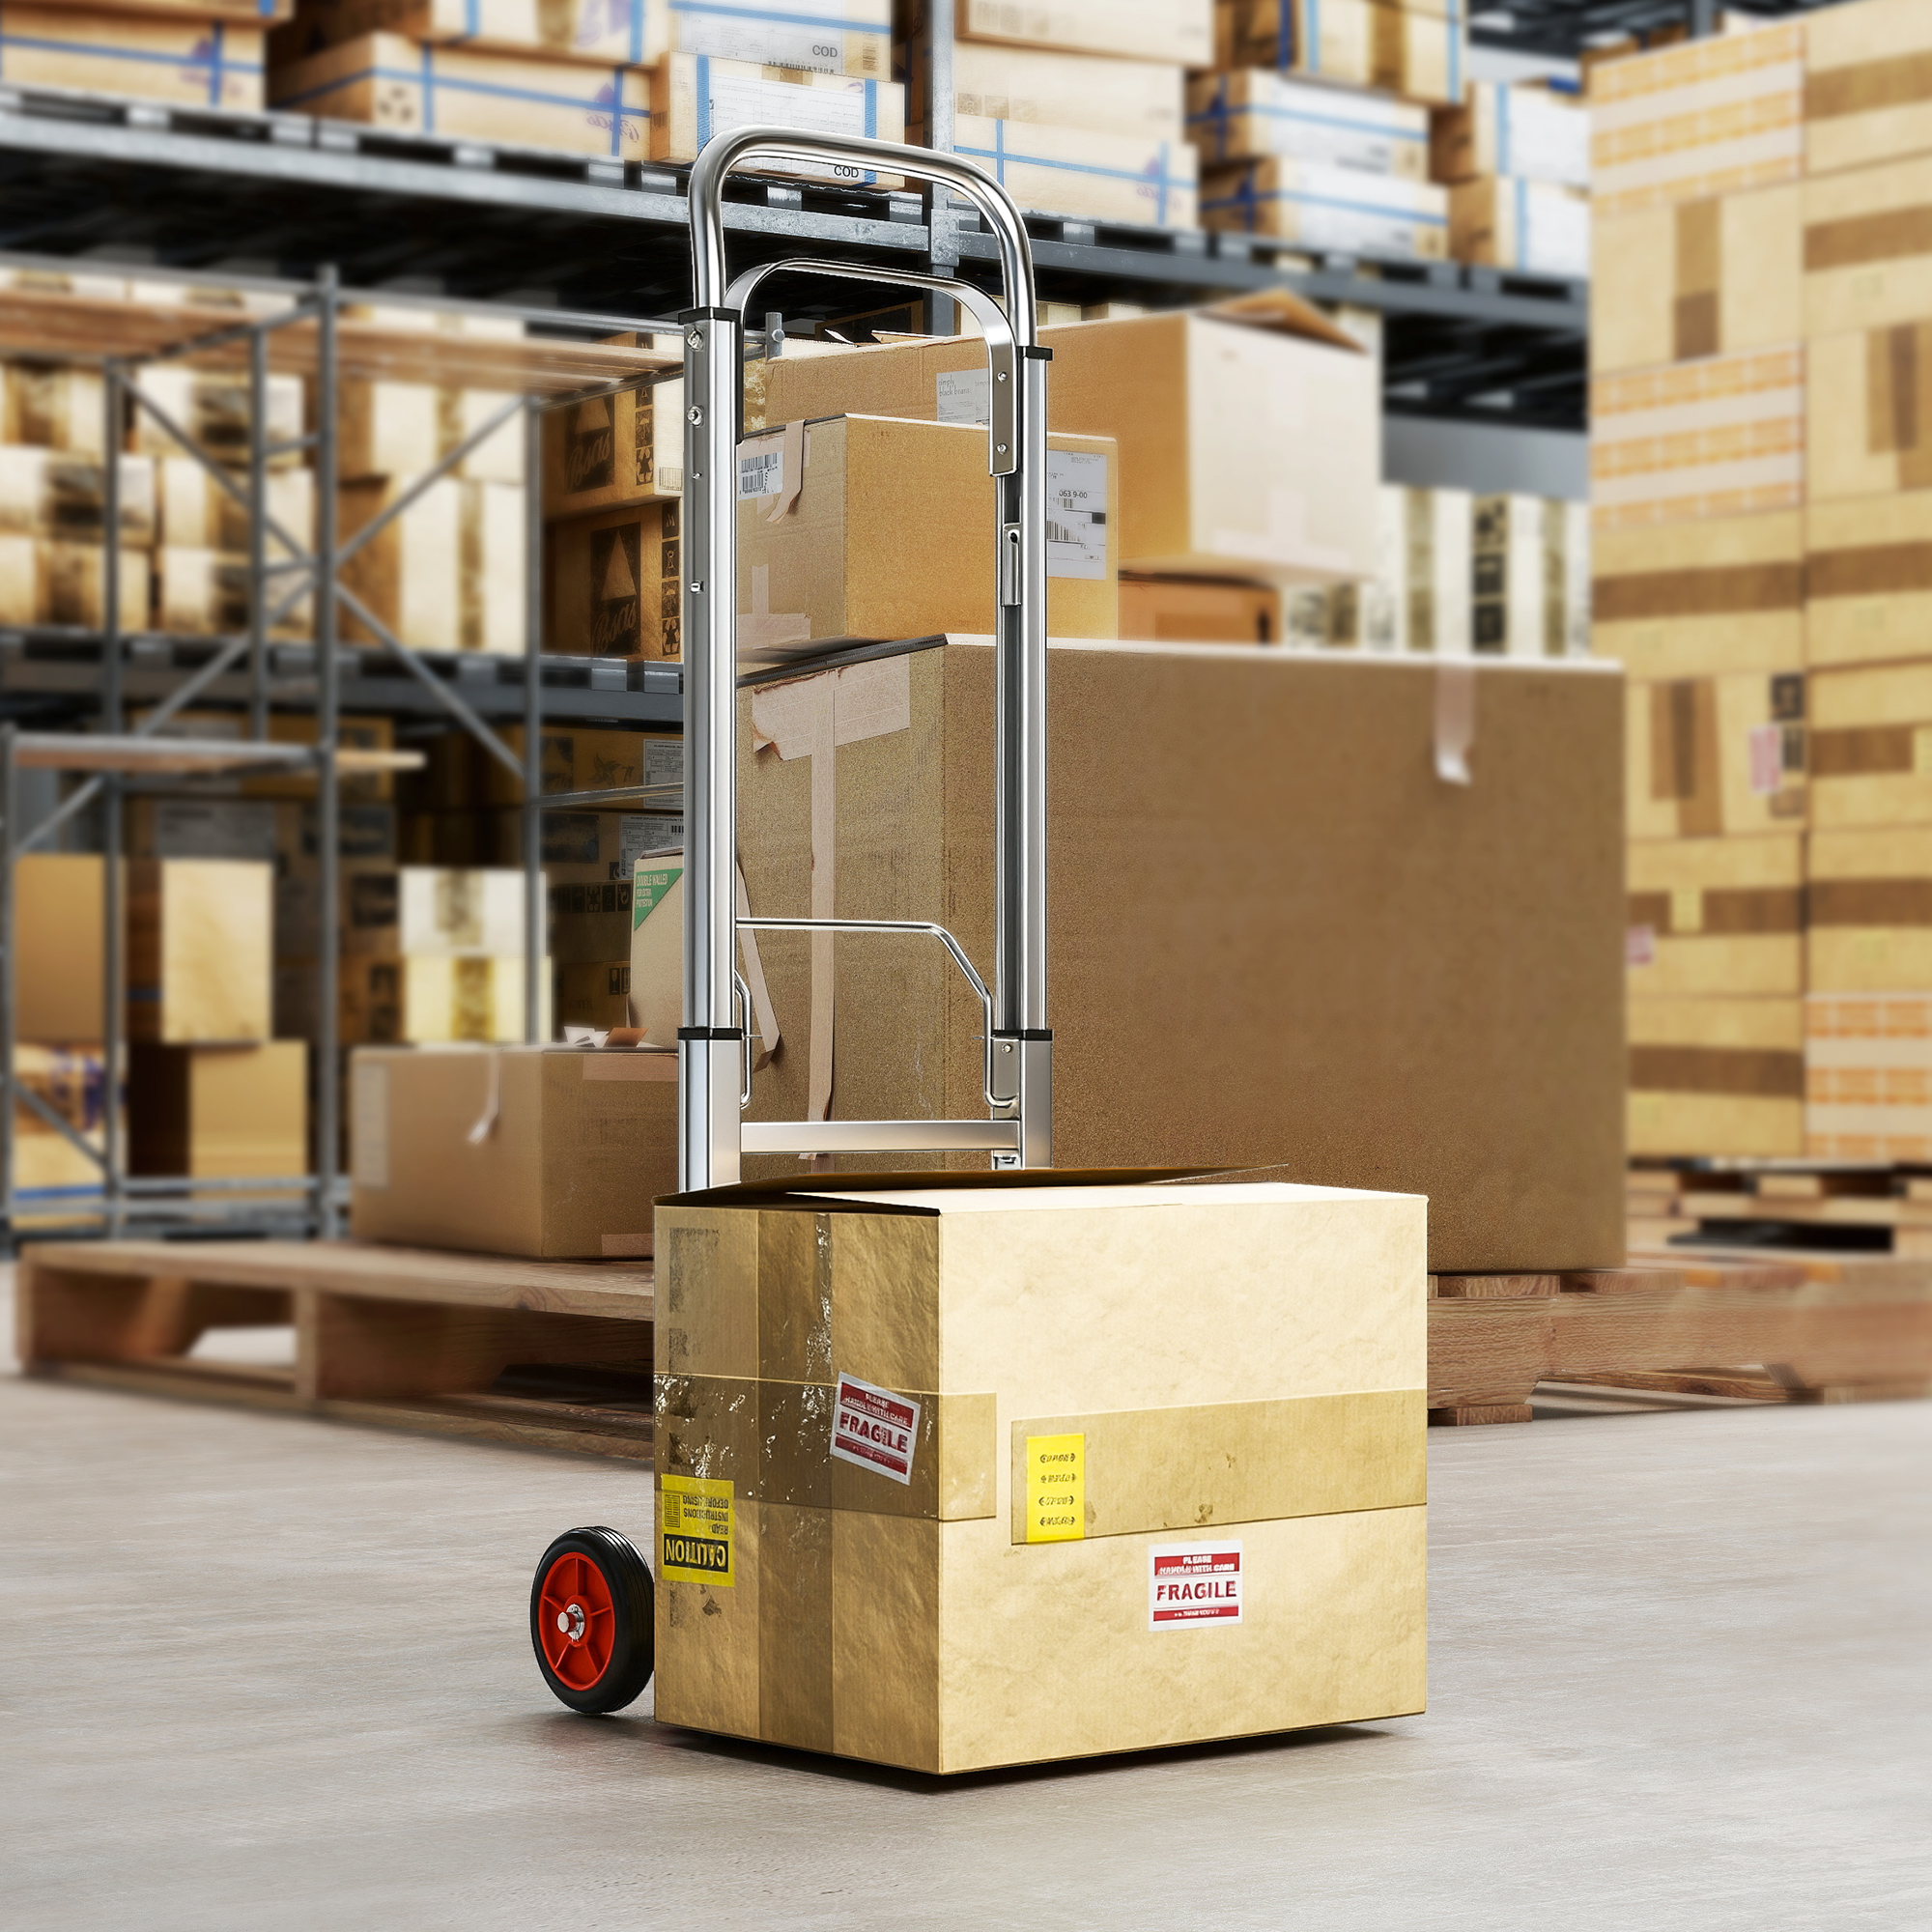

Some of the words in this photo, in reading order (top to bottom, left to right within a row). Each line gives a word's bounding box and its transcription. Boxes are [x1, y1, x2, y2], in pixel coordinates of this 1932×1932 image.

[812, 44, 838, 58] COD
[834, 165, 860, 178] COD
[637, 874, 652, 887] DOUBLE
[653, 873, 668, 886] WALLED
[839, 1411, 908, 1454] FRAGILE
[711, 1524, 728, 1535] READ
[666, 1539, 726, 1567] CAUTION
[1182, 1555, 1212, 1565] PLEASE
[1193, 1564, 1212, 1573] WITH
[1213, 1563, 1235, 1572] CARE
[1157, 1580, 1237, 1601] FRAGILE
